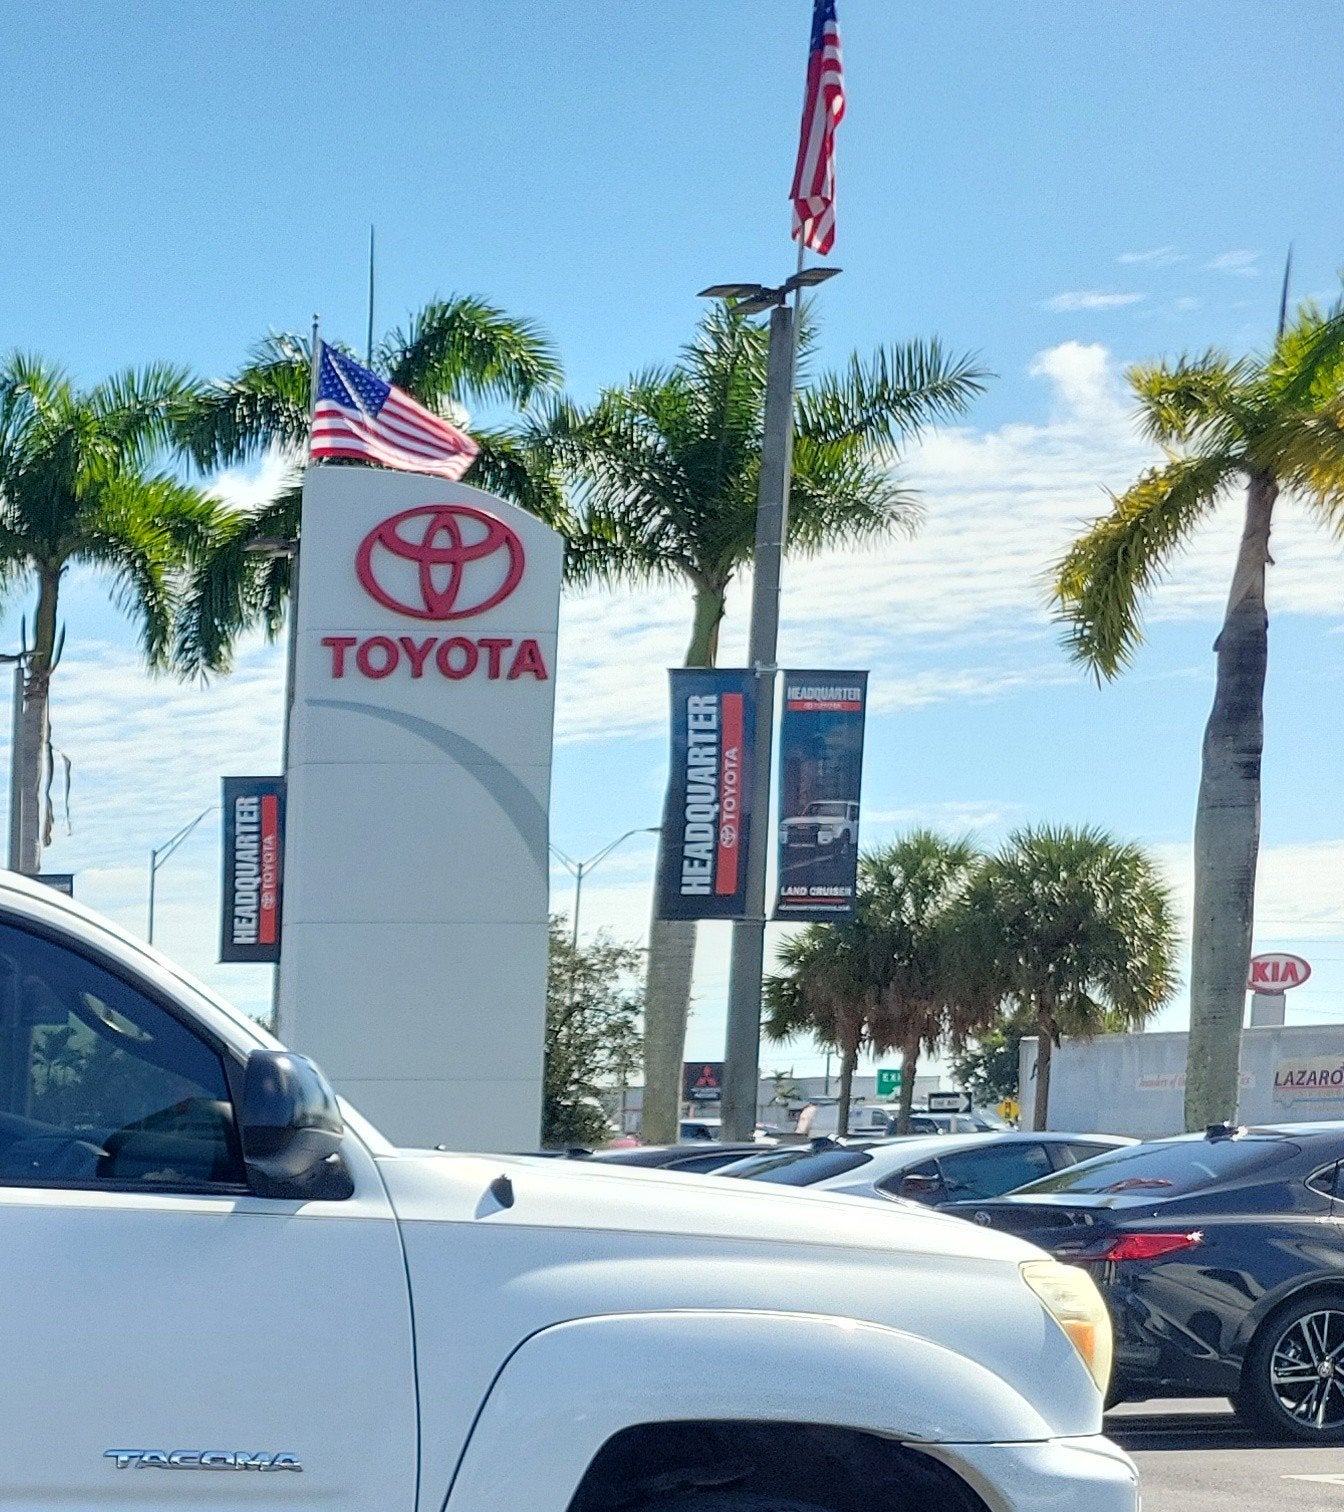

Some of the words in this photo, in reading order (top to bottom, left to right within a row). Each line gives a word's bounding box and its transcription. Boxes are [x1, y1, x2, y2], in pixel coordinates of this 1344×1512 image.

[321, 636, 549, 680] TOYOTA
[679, 694, 720, 896] HEADQUARTER
[722, 747, 739, 822] TOYOTA
[233, 796, 262, 945] HEADQUARTER
[262, 832, 277, 889] TOYOTA
[780, 885, 808, 896] LAND
[1252, 961, 1300, 983] KIA
[102, 1449, 304, 1473] TACOMA
